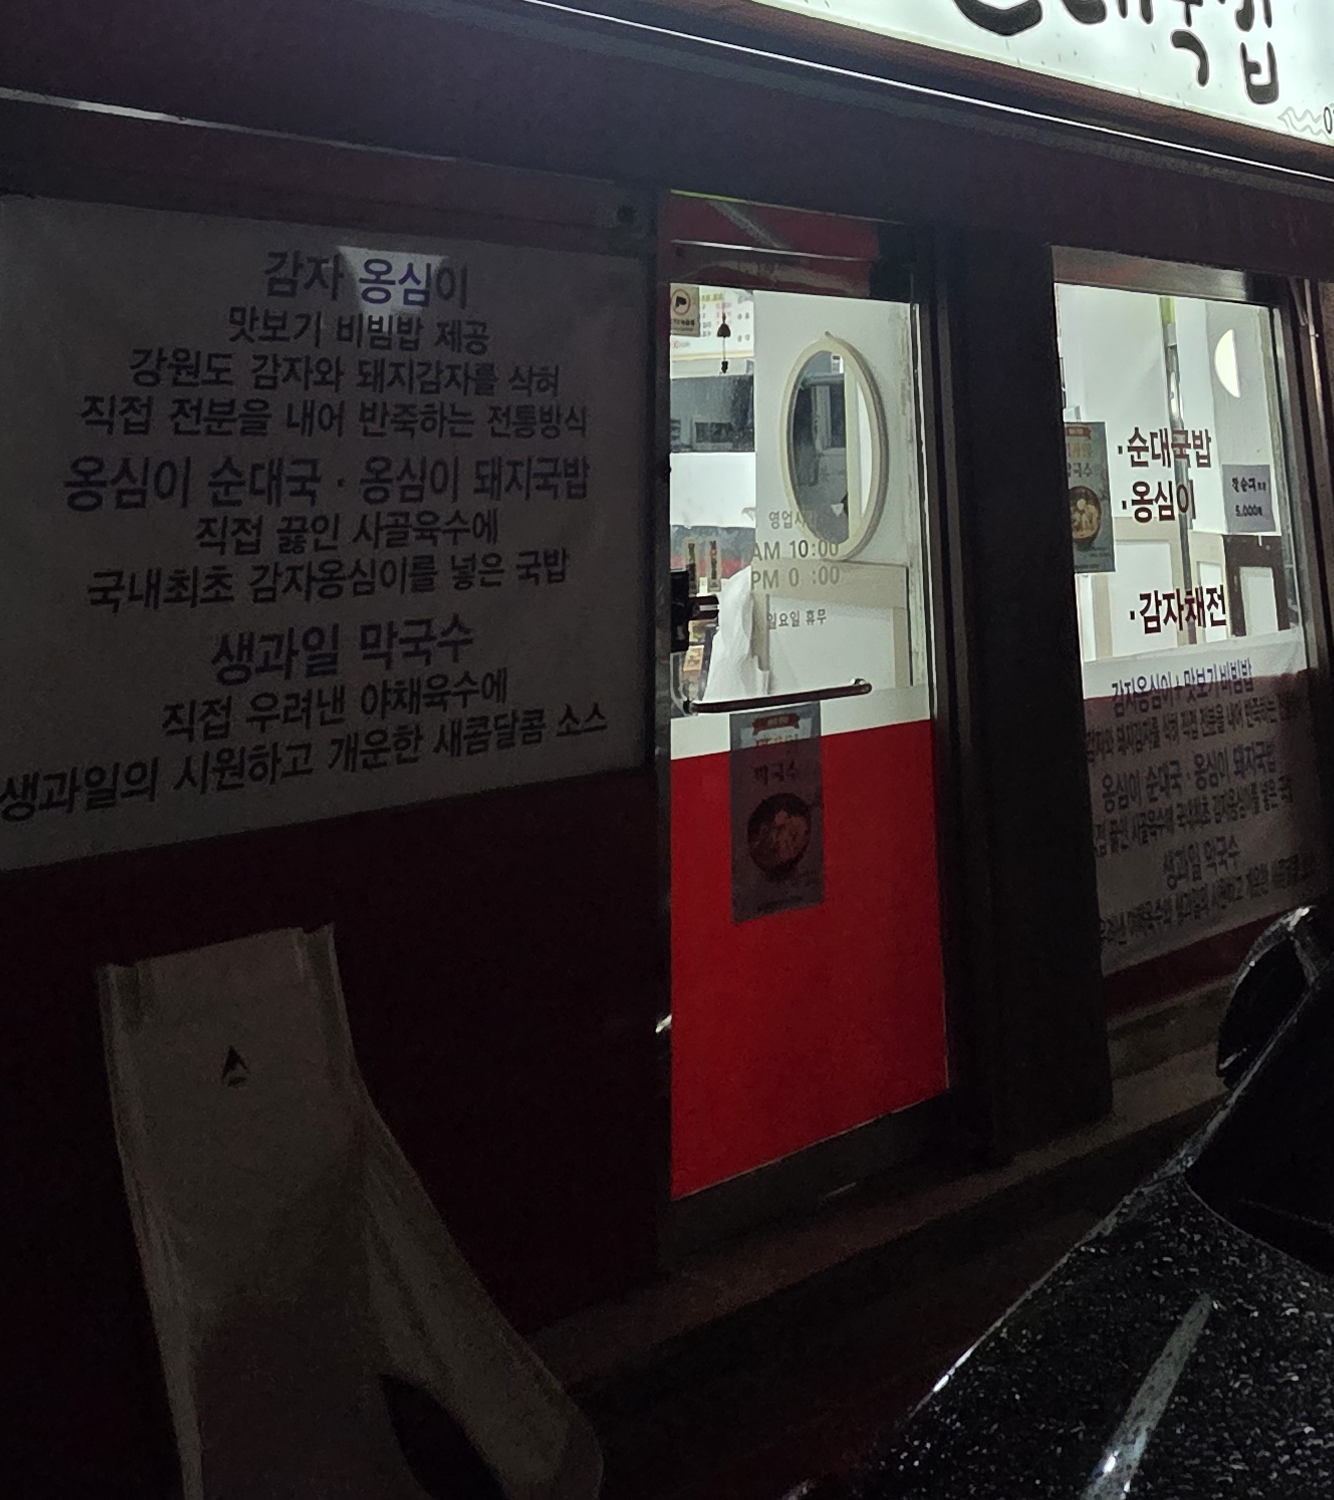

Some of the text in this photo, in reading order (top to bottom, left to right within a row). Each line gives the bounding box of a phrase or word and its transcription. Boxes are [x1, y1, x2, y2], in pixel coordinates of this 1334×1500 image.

[264, 251, 468, 308] 감자 옹심이
[228, 306, 491, 355] 맛보기 비빔밥 제공
[128, 348, 233, 388] 강원도
[250, 353, 345, 392] 감자와
[356, 358, 499, 398] 돼지감자를
[80, 395, 588, 440] 직접 전분을 내어 반죽하는 전통방식
[1127, 426, 1212, 469] 순대국밥
[63, 455, 589, 512] 옹심이 순대국 옹심이 돼지국밥
[1131, 480, 1197, 523] 옹심이
[196, 509, 500, 556] 직접 끓인 사골육수에
[752, 540, 840, 561] AM 10:00
[88, 547, 569, 613] 국내최초 감자옹심이를 넣은 국밥
[751, 569, 779, 590] PM
[767, 609, 827, 629] 일요일 휴무
[1139, 584, 1227, 634] 감자채전
[211, 613, 474, 686] 생과일 막국수
[161, 667, 508, 741] 직접 우려낸 야채육수에
[1111, 671, 1174, 717] 감자옹심이
[1184, 664, 1217, 699] 맛보기
[1219, 657, 1255, 693] 비빔밥
[174, 740, 315, 795] 시원하고
[328, 722, 424, 772] 개운한
[433, 706, 545, 757] 새콤달콤
[557, 702, 608, 739] 소스
[1101, 769, 1141, 811] 옹심이
[1144, 761, 1182, 801] 순대국
[1193, 749, 1230, 789] 옹심이
